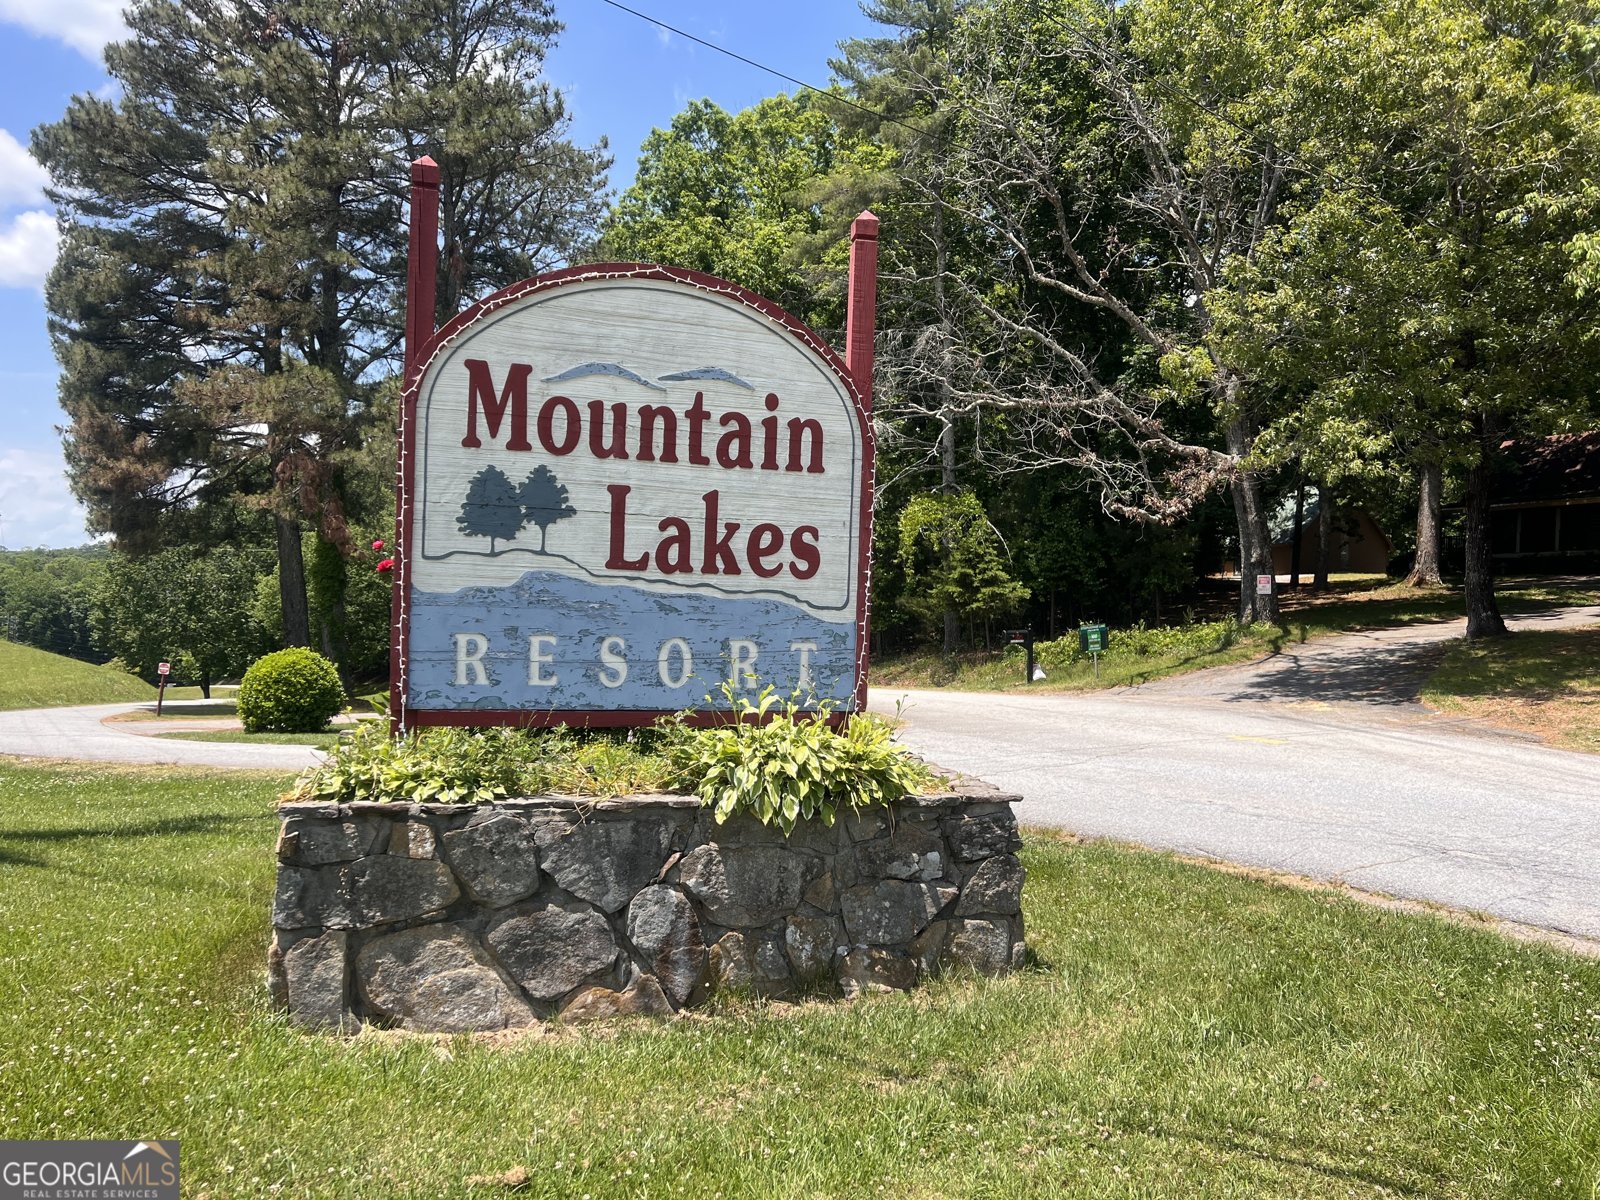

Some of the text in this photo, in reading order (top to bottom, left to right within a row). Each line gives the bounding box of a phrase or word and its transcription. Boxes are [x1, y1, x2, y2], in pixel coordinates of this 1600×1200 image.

[461, 358, 826, 474] Mountain
[604, 484, 821, 580] Lakes
[453, 632, 818, 690] RESORT
